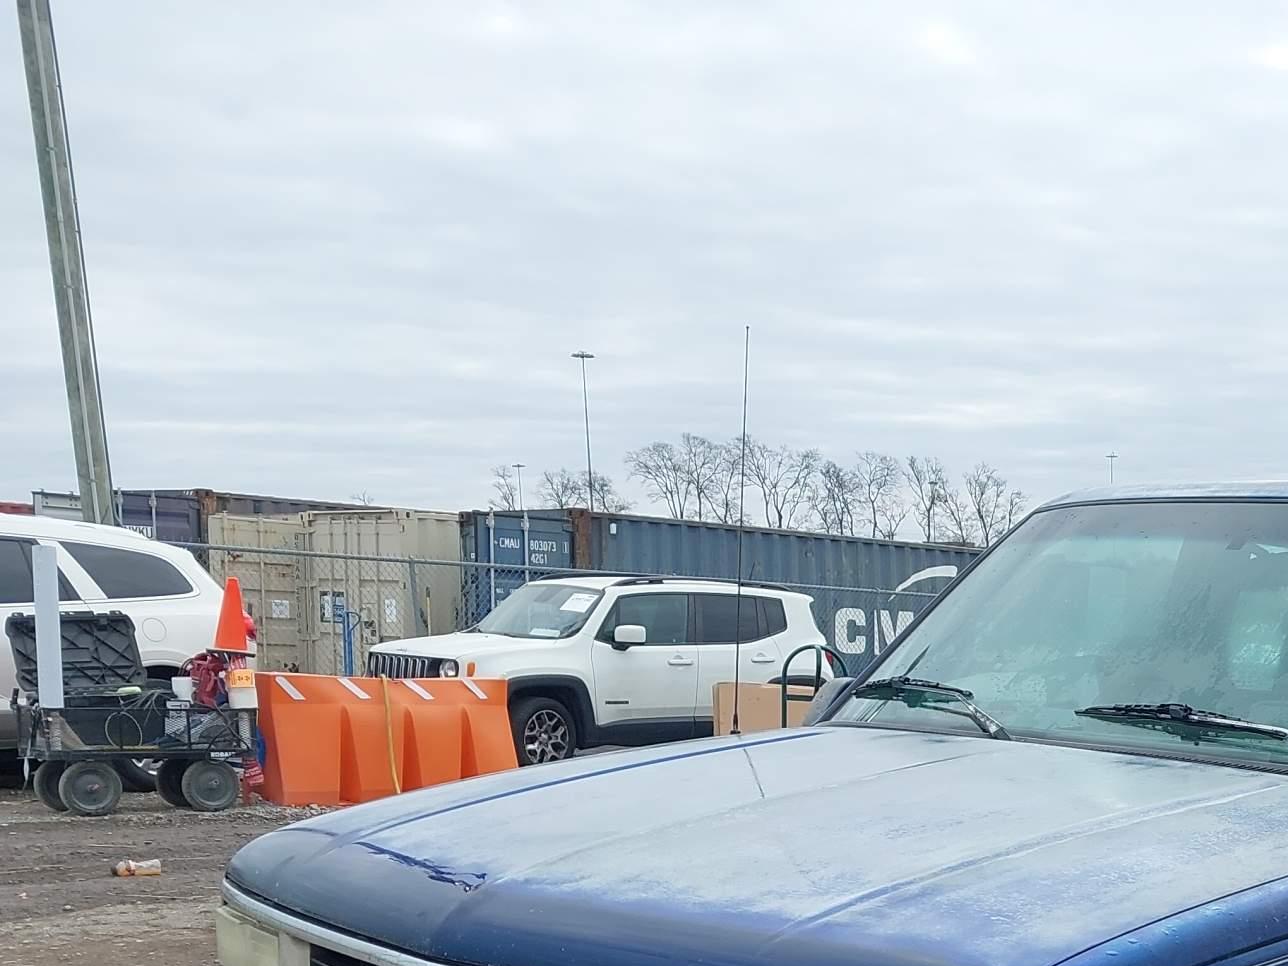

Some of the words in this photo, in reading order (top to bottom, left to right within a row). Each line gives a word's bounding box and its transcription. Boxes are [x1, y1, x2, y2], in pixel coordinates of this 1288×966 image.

[499, 537, 520, 549] CMAU
[529, 540, 557, 552] 803073
[530, 553, 548, 565] 42G1
